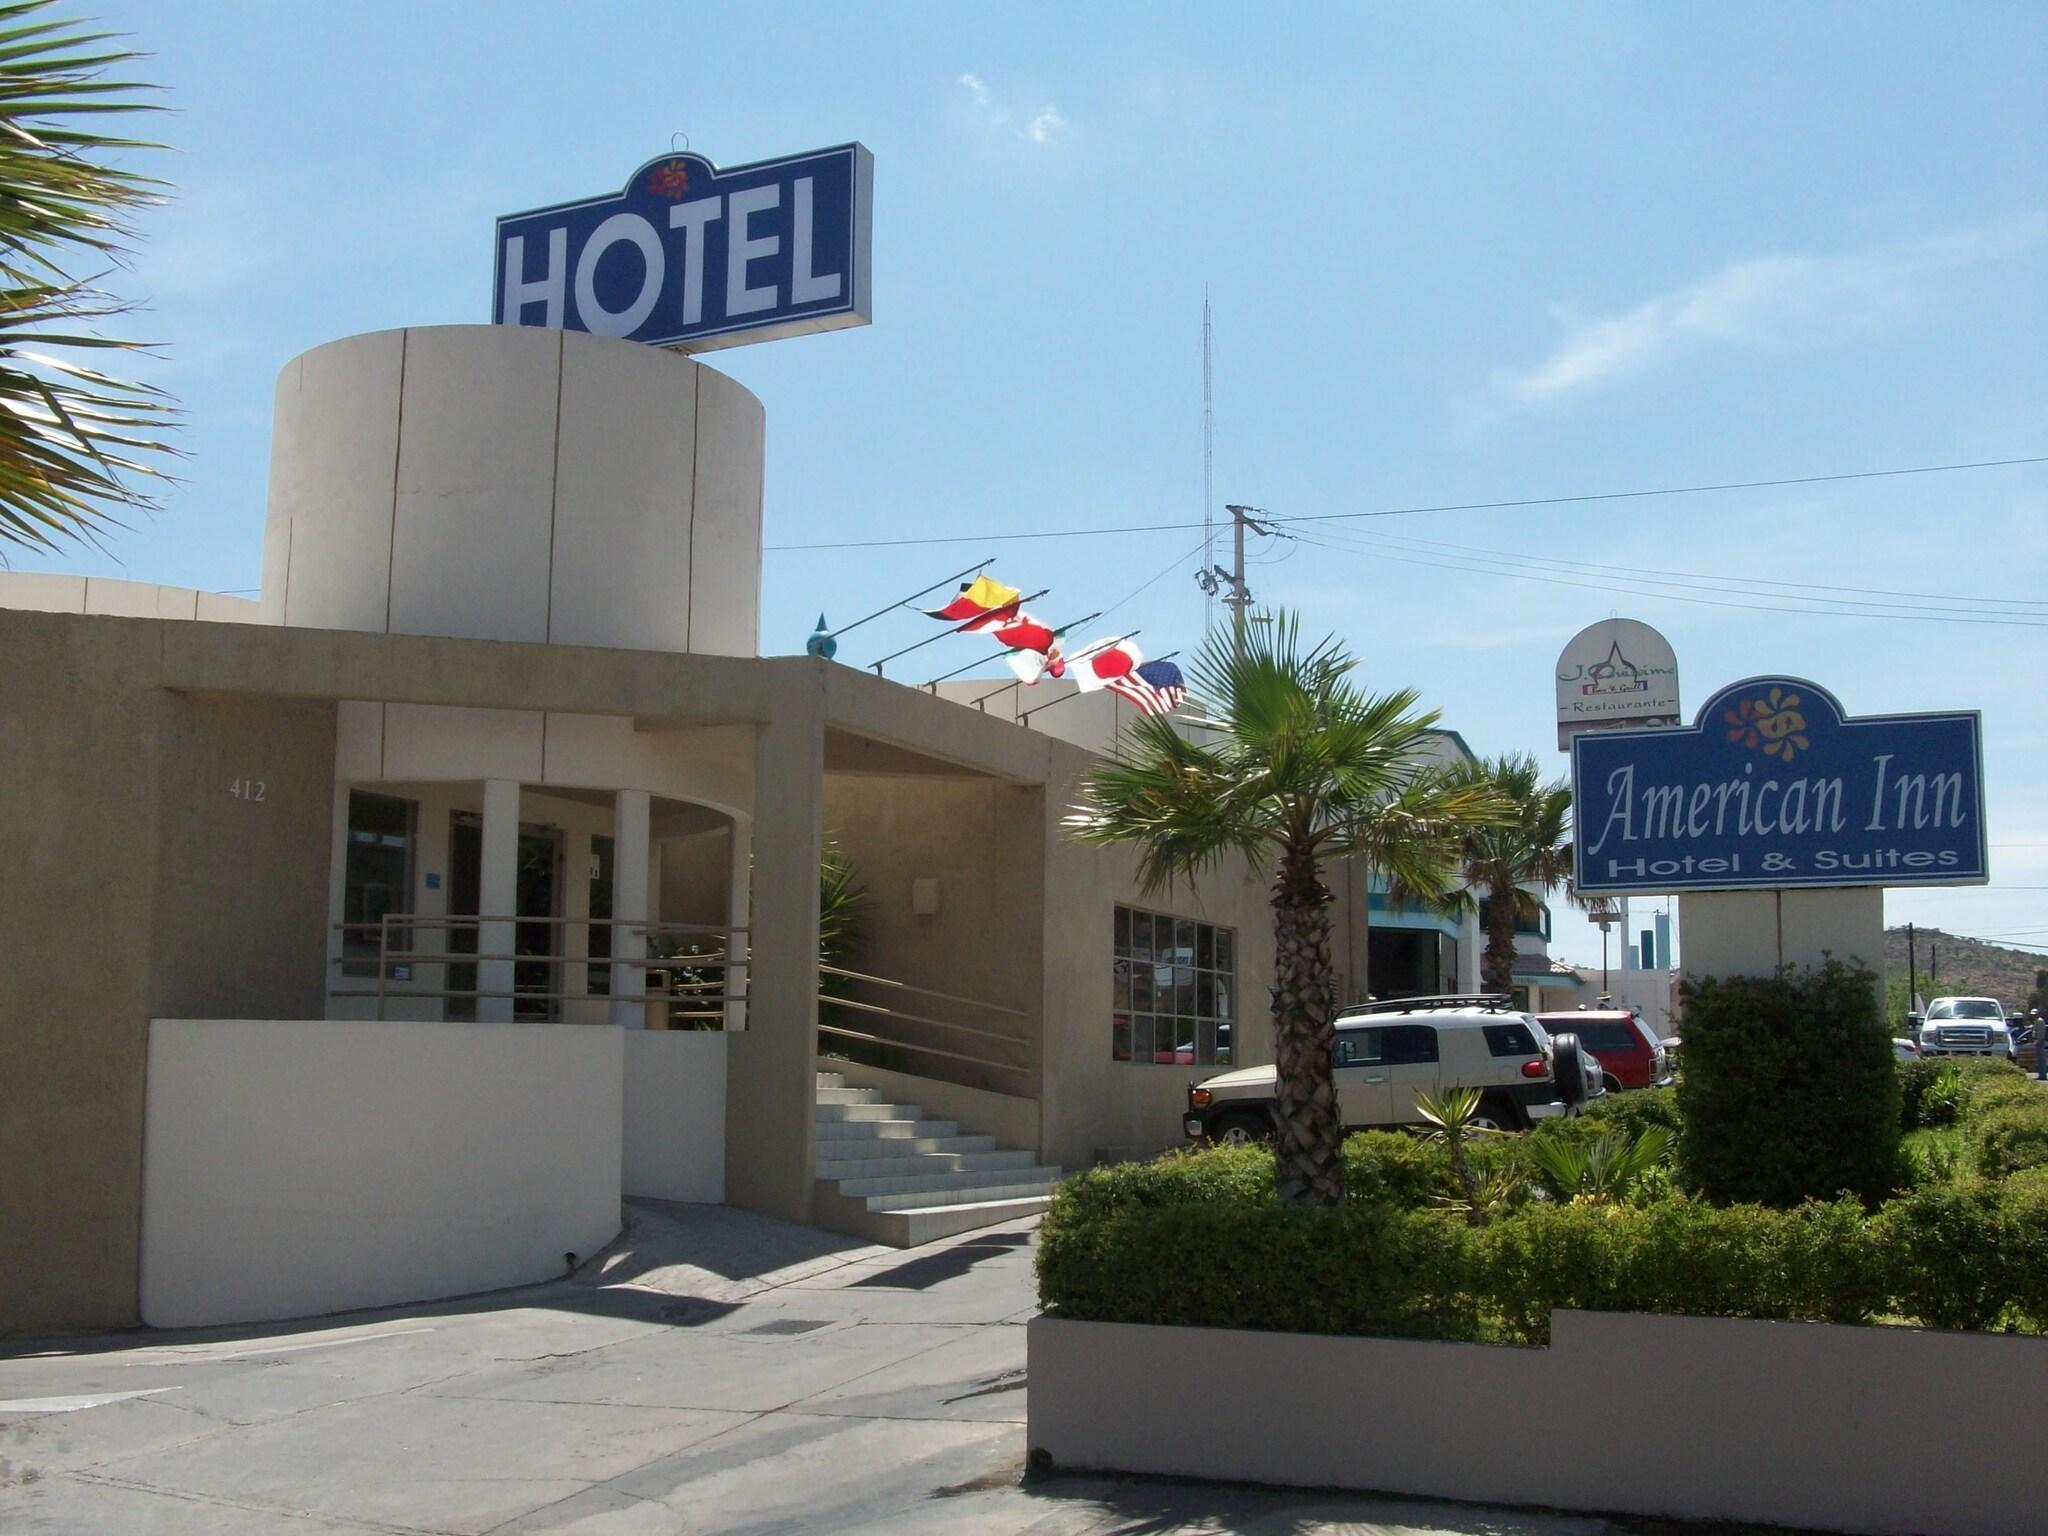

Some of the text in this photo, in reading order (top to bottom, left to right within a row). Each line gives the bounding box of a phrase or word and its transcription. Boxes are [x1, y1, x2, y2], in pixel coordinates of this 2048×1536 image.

[503, 176, 841, 339] HOTEL
[1572, 698, 1666, 713] Restaurante
[229, 778, 265, 802] 412
[1587, 754, 1967, 856] American Inn
[1607, 849, 1960, 878] Hotel & Suites
